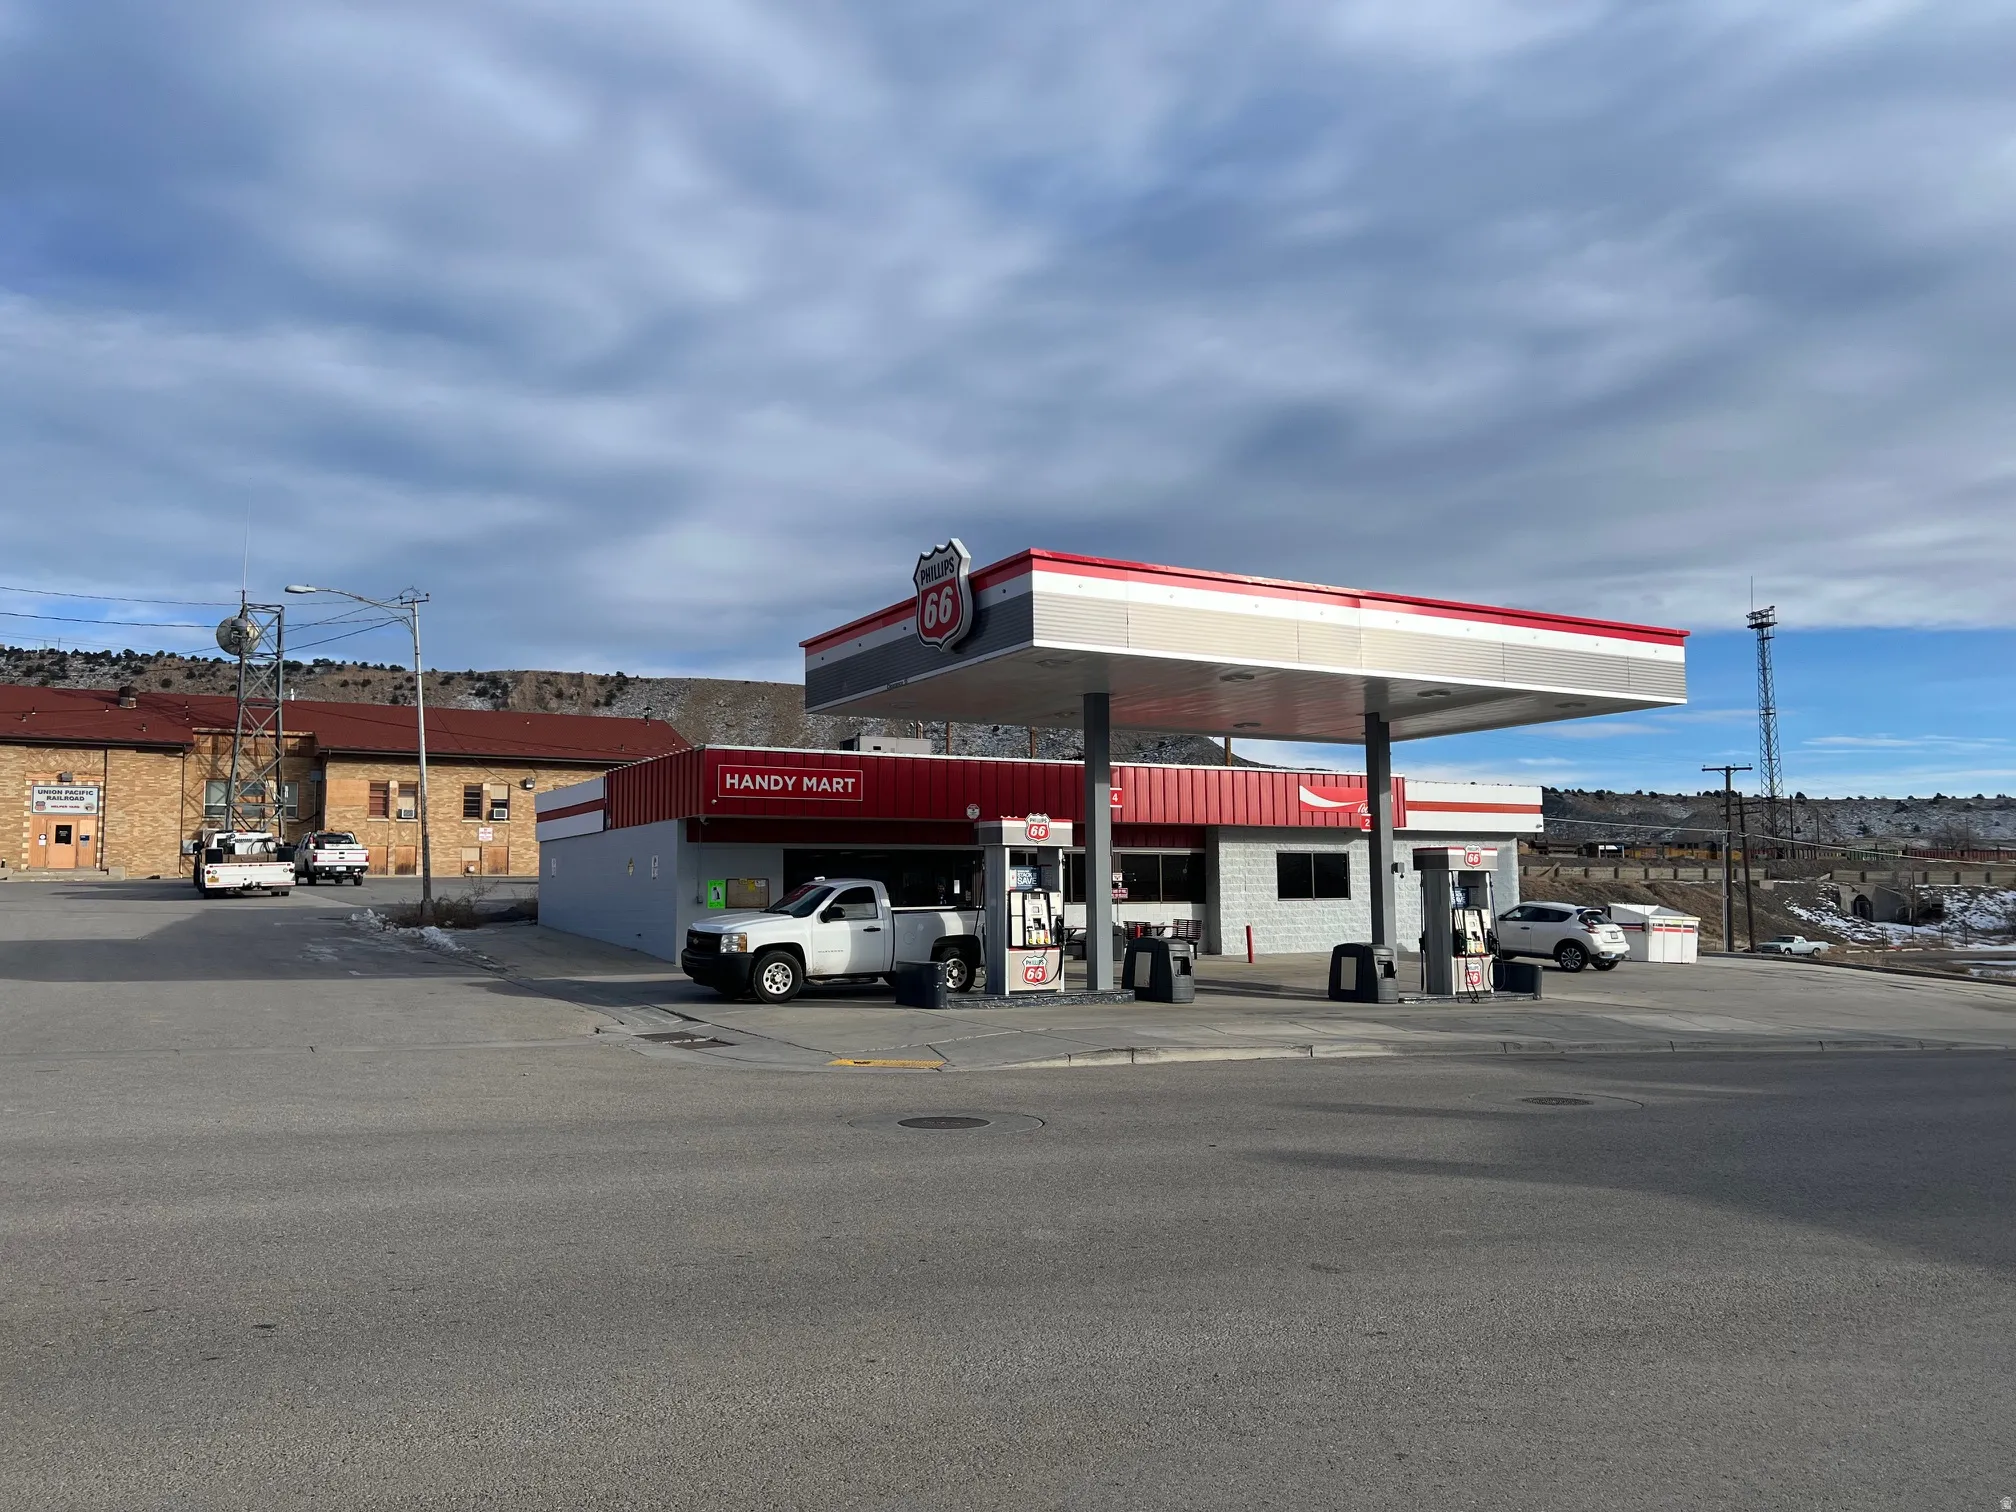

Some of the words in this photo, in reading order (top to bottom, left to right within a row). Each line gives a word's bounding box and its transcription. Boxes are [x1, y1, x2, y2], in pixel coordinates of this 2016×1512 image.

[920, 556, 955, 586] PHILLIPS
[924, 586, 953, 629] 66
[725, 773, 797, 791] HANDY
[802, 776, 856, 793] MART
[1112, 793, 1118, 802] 4
[1365, 819, 1371, 827] 2
[1030, 825, 1046, 837] 66
[1468, 853, 1479, 863] 66
[1017, 877, 1037, 885] SAVE
[1027, 968, 1043, 980] 66
